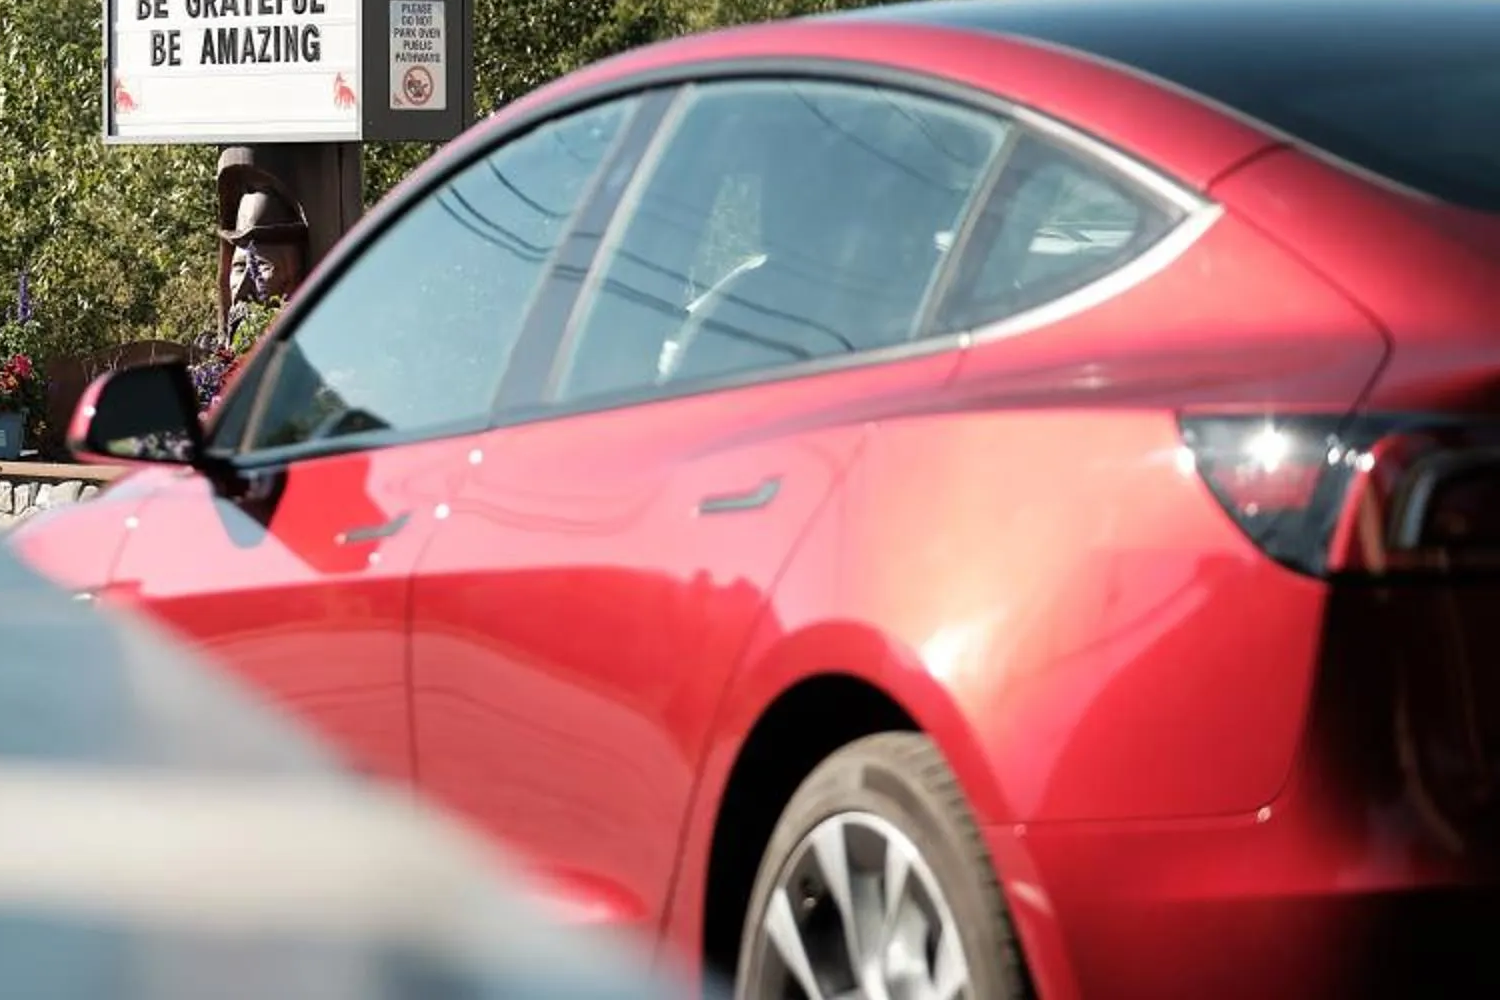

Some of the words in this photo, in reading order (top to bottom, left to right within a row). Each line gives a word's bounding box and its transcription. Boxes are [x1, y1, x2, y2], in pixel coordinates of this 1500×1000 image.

[401, 3, 432, 14] PLEASE
[401, 15, 414, 26] DO
[416, 15, 432, 26] NOT
[393, 27, 416, 38] PARK
[419, 27, 440, 38] OVER
[151, 30, 181, 66] BE
[200, 24, 321, 65] AMAZING
[403, 40, 433, 50] PUBLIC
